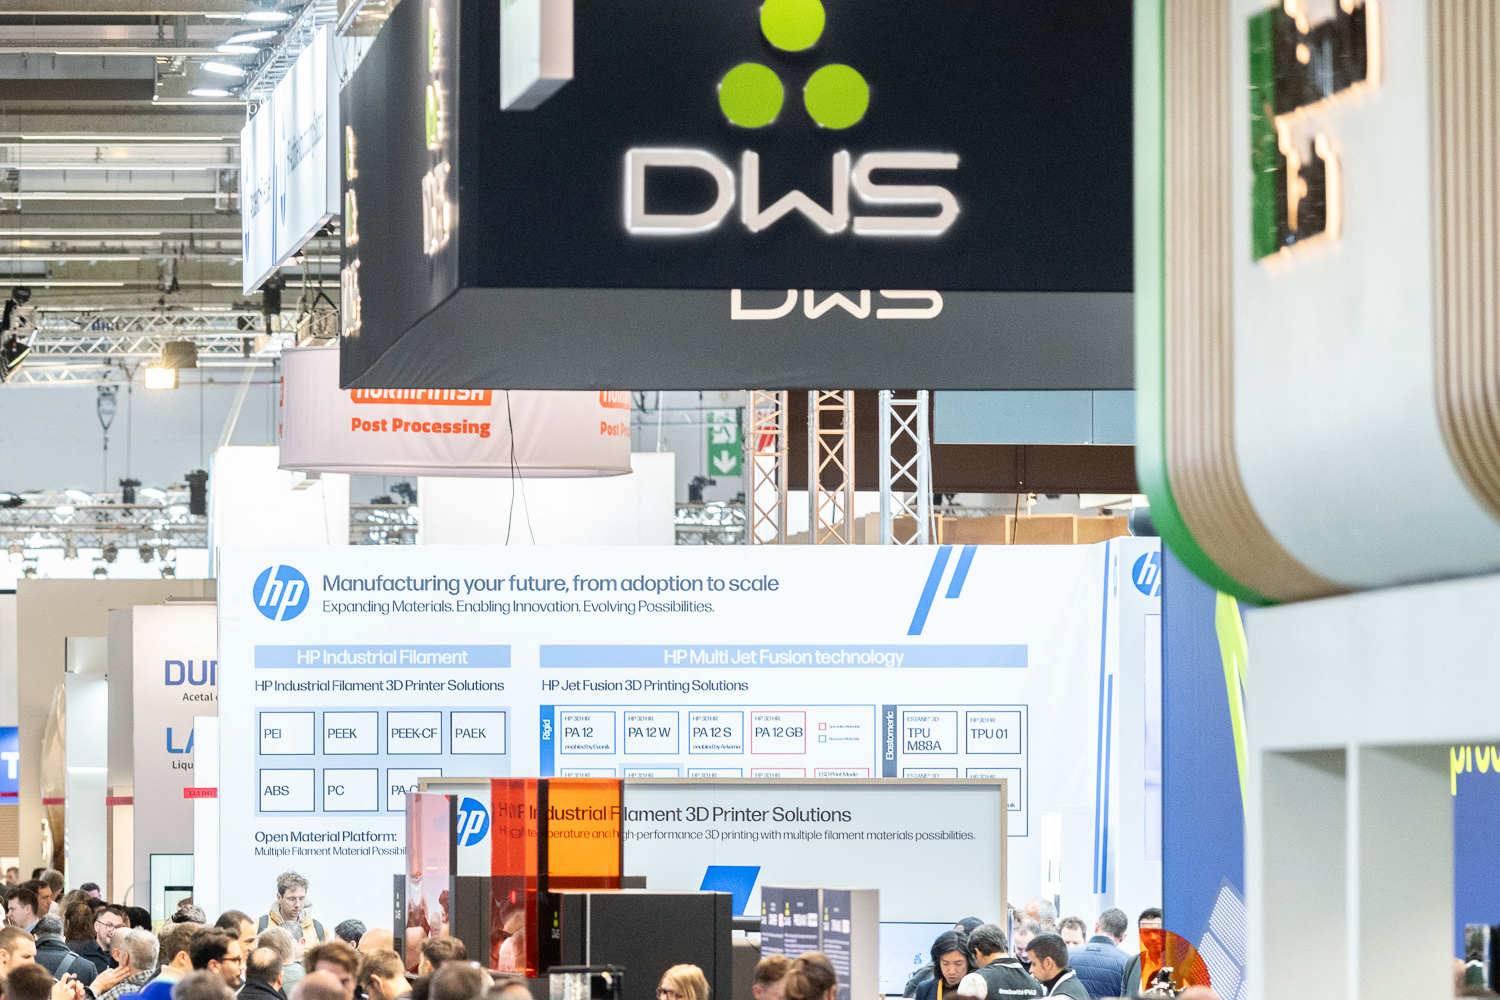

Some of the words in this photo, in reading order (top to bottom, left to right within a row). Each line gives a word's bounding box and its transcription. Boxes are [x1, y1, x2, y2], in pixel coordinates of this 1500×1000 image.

[625, 147, 961, 236] DWS
[351, 417, 388, 432] Post
[392, 417, 491, 438] Processing
[600, 421, 619, 437] Post
[1132, 551, 1162, 597] h
[323, 574, 460, 595] Manufacturing
[464, 579, 505, 594] your
[509, 574, 569, 595] future,
[573, 574, 618, 592] from
[620, 574, 703, 595] adoption
[706, 577, 726, 592] to
[729, 574, 780, 592] scale
[253, 564, 310, 622] hp
[322, 599, 390, 615] Expanding
[392, 599, 455, 613] Materials.
[456, 599, 510, 615] Enabling
[513, 599, 581, 613] Innovation.
[583, 599, 636, 615] Evolving
[638, 599, 715, 613] Possibilities.
[297, 649, 321, 665] HP
[323, 649, 397, 665] Industrial
[400, 649, 469, 665] Filament
[663, 649, 688, 665] HP
[690, 649, 729, 665] Multi
[730, 649, 758, 665] Jet
[760, 649, 813, 665] Fusion
[815, 649, 905, 668] technology
[255, 679, 273, 692] HP
[274, 679, 330, 692] Industrial
[332, 679, 384, 692] Filament
[386, 679, 404, 692] 3D
[405, 679, 446, 692] Printer
[447, 679, 505, 692] Solutions
[541, 679, 560, 692] HP
[561, 679, 581, 692] Jet
[582, 679, 623, 692] Fusion
[624, 679, 642, 692] 3D
[644, 679, 690, 694] Printing
[691, 679, 749, 692] Solutions
[182, 692, 213, 702] Acetal
[264, 728, 282, 739] PEI
[327, 728, 358, 739] PEEK
[391, 728, 438, 739] PEEK-CF
[455, 728, 487, 739] PAEK
[542, 718, 553, 741] Rigid
[564, 727, 580, 738] PA
[583, 727, 594, 738] 12
[628, 727, 644, 738] PA
[646, 727, 657, 738] 12
[658, 727, 671, 738] W
[693, 727, 708, 738] PA
[710, 727, 722, 738] 12
[723, 727, 732, 738] S
[755, 727, 770, 738] PA
[772, 727, 784, 738] 12
[785, 727, 803, 738] GB
[885, 711, 895, 761] Elastomeric
[907, 728, 931, 739] TPU
[970, 729, 994, 739] TPU
[995, 729, 1008, 739] 01
[907, 741, 942, 751] M88A
[263, 785, 290, 796] ABS
[327, 785, 345, 796] PC
[610, 805, 683, 822] Flament
[685, 806, 710, 822] 3D
[712, 806, 770, 822] Printer
[772, 806, 852, 823] Solutions
[254, 831, 289, 845] Open
[290, 831, 340, 842] Material
[342, 831, 397, 842] Platform:
[527, 829, 590, 840] teperature
[612, 829, 704, 842] hgh-performance
[704, 829, 720, 840] 3D
[721, 829, 759, 842] printing
[760, 829, 782, 840] with
[783, 829, 822, 842] multiple
[824, 829, 865, 840] filament
[866, 829, 914, 840] materials
[915, 829, 976, 842] possibilities.
[254, 846, 290, 856] Multiple
[292, 846, 331, 855] Filament
[334, 846, 370, 855] Material
